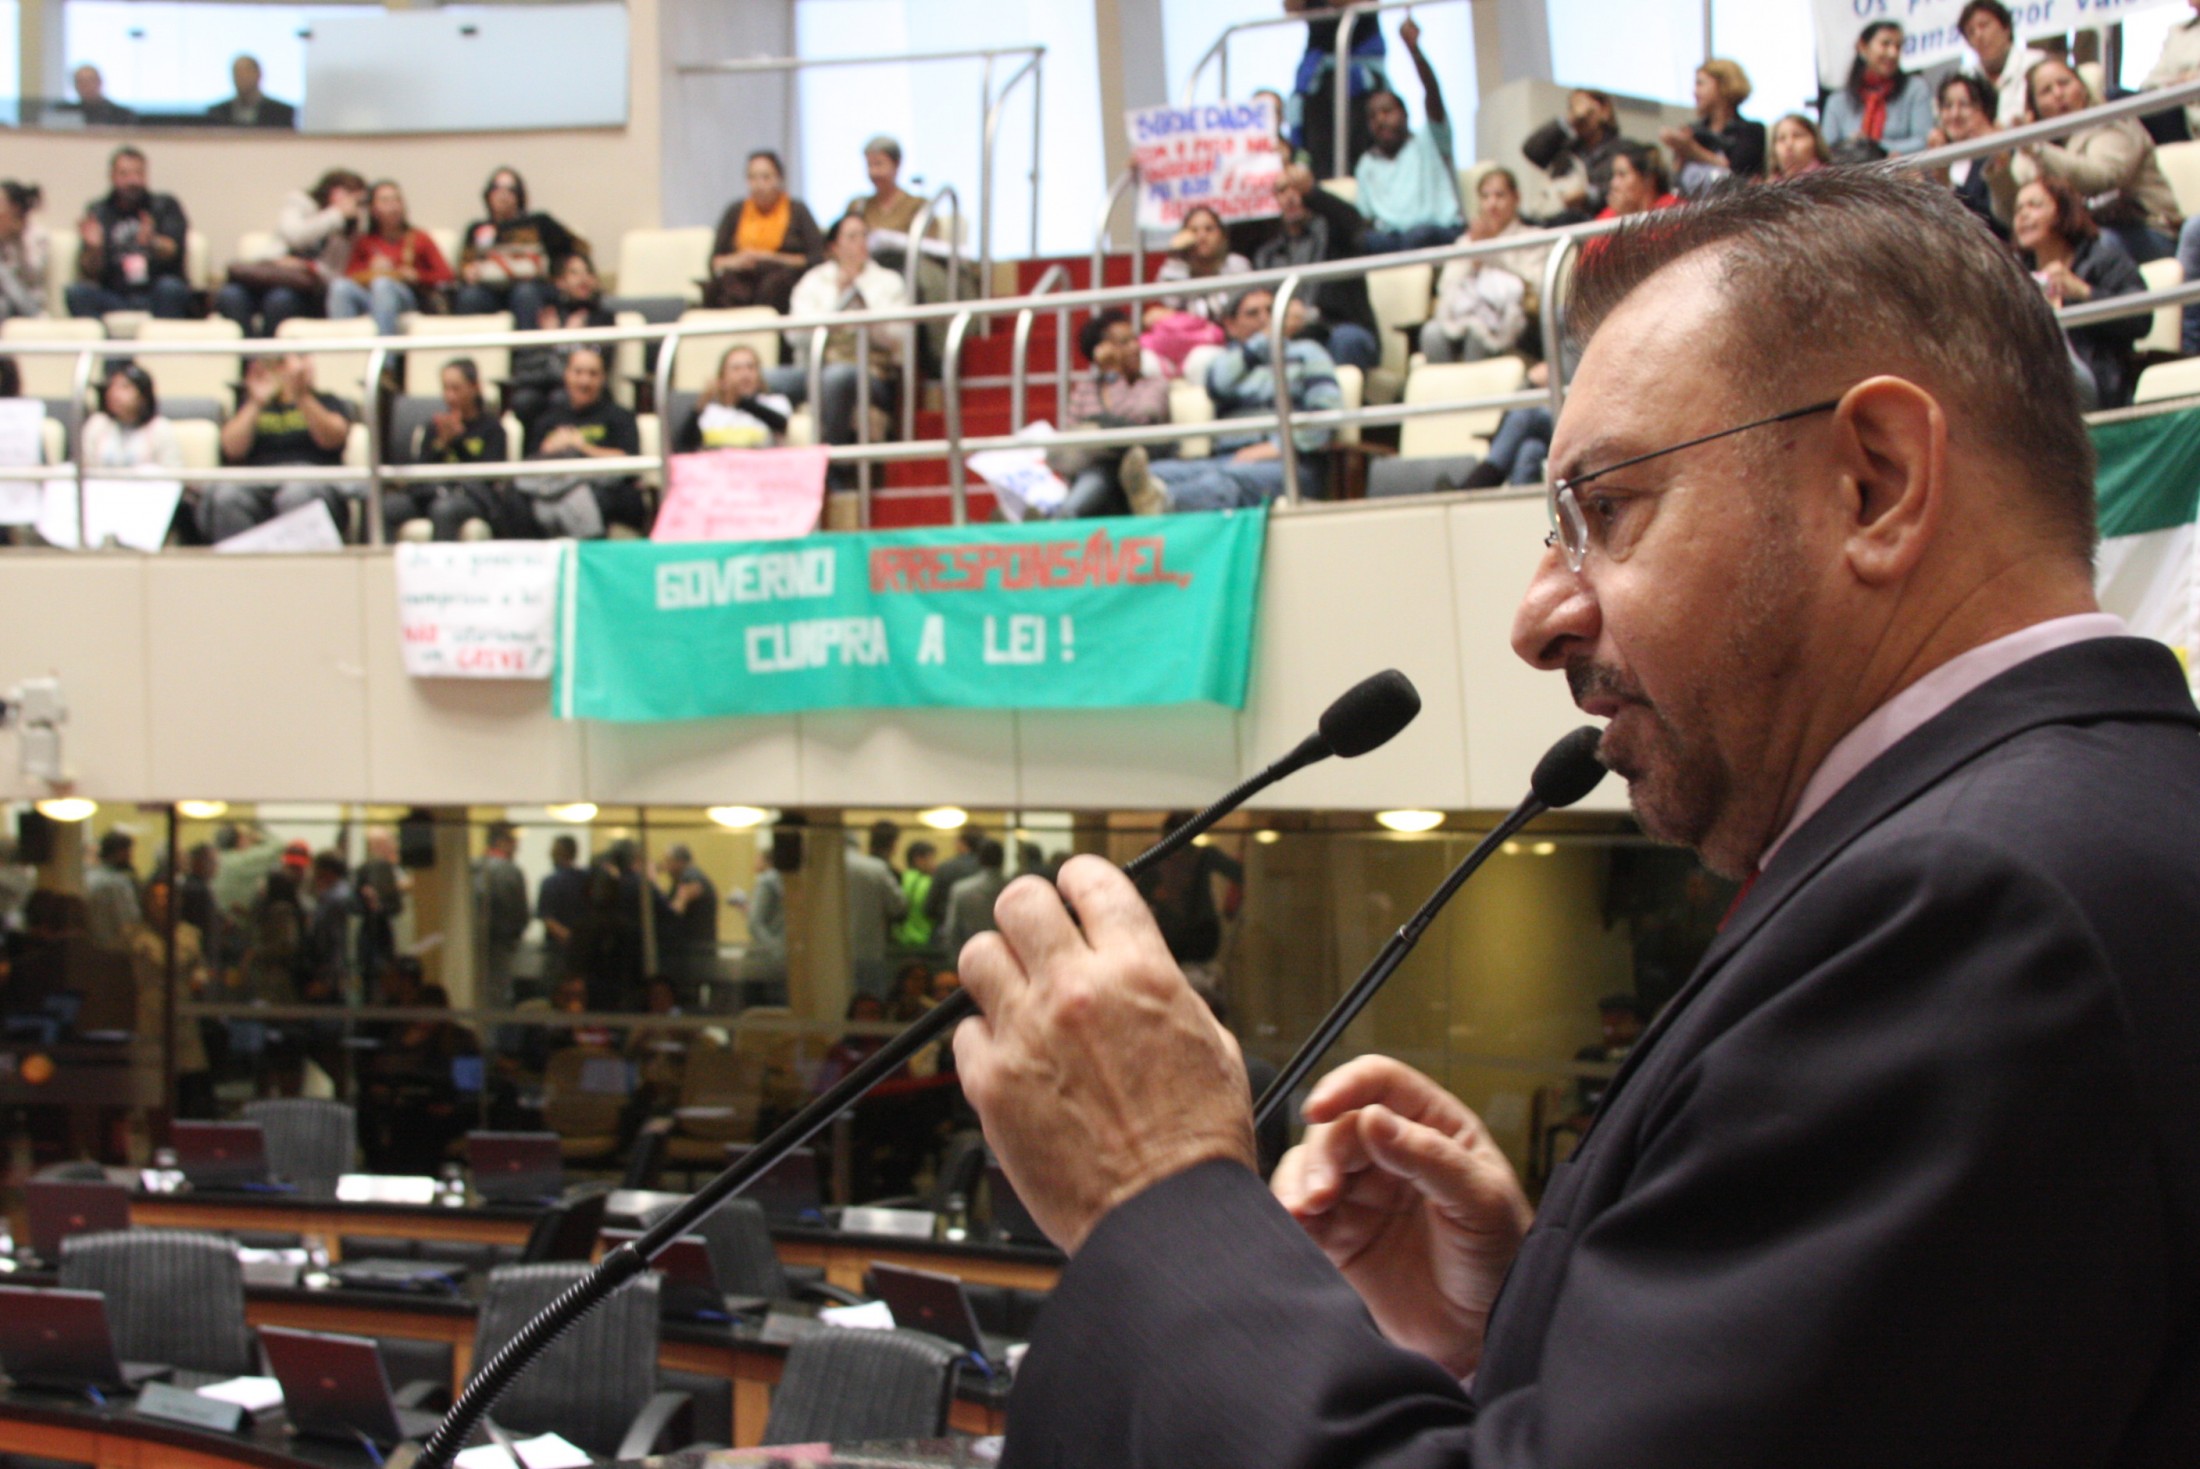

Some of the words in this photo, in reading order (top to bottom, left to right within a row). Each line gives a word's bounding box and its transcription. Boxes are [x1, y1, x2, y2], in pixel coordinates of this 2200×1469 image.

[655, 547, 836, 610] GOVERNO
[744, 614, 889, 673] CUMPRA
[917, 613, 945, 665] A
